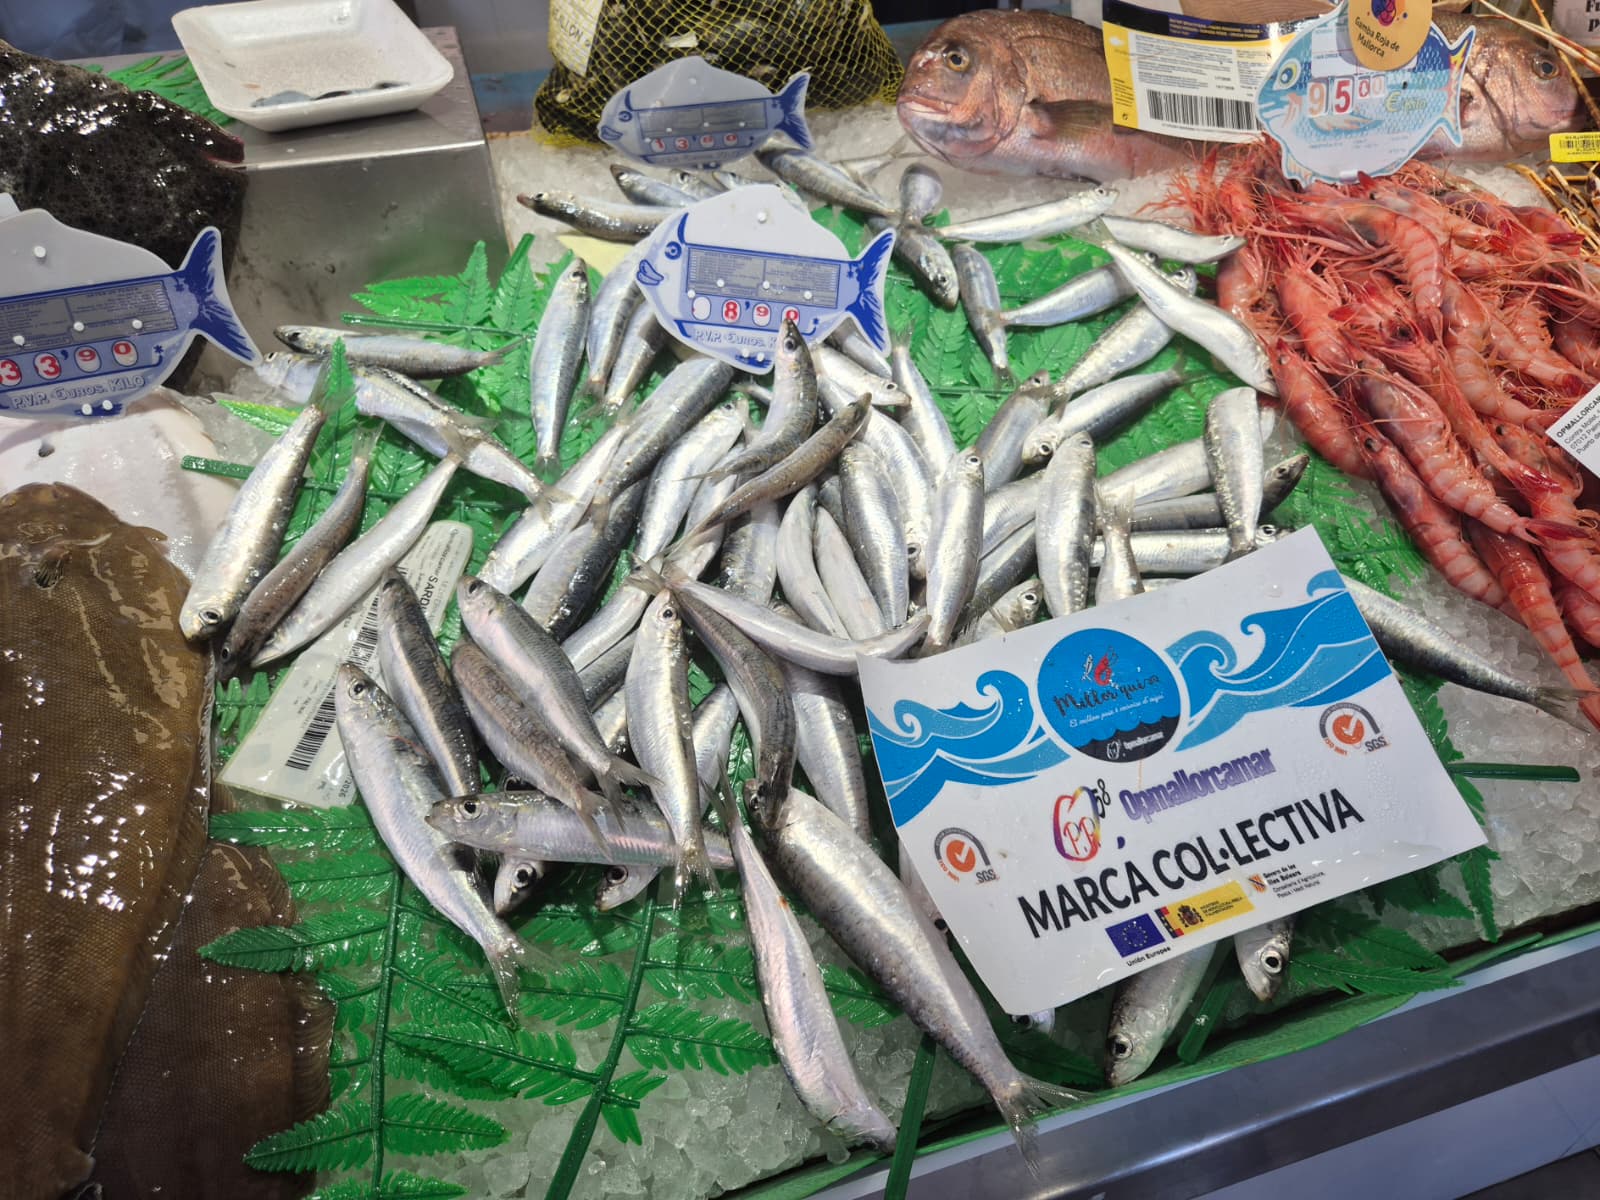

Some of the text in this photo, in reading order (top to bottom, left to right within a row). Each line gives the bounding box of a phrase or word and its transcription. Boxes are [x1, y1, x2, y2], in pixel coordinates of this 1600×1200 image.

[1354, 16, 1375, 38] Gamba
[1375, 31, 1391, 47] Roja
[1390, 40, 1400, 52] de
[1357, 33, 1385, 58] Mallorca
[107, 374, 146, 391] KILO
[1364, 736, 1388, 752] SGS
[1118, 748, 1276, 825] Opmallorcamar
[1018, 787, 1366, 939] MARCA COL·LECTIVA
[976, 868, 997, 884] SGS
[1126, 954, 1147, 967] Unión
